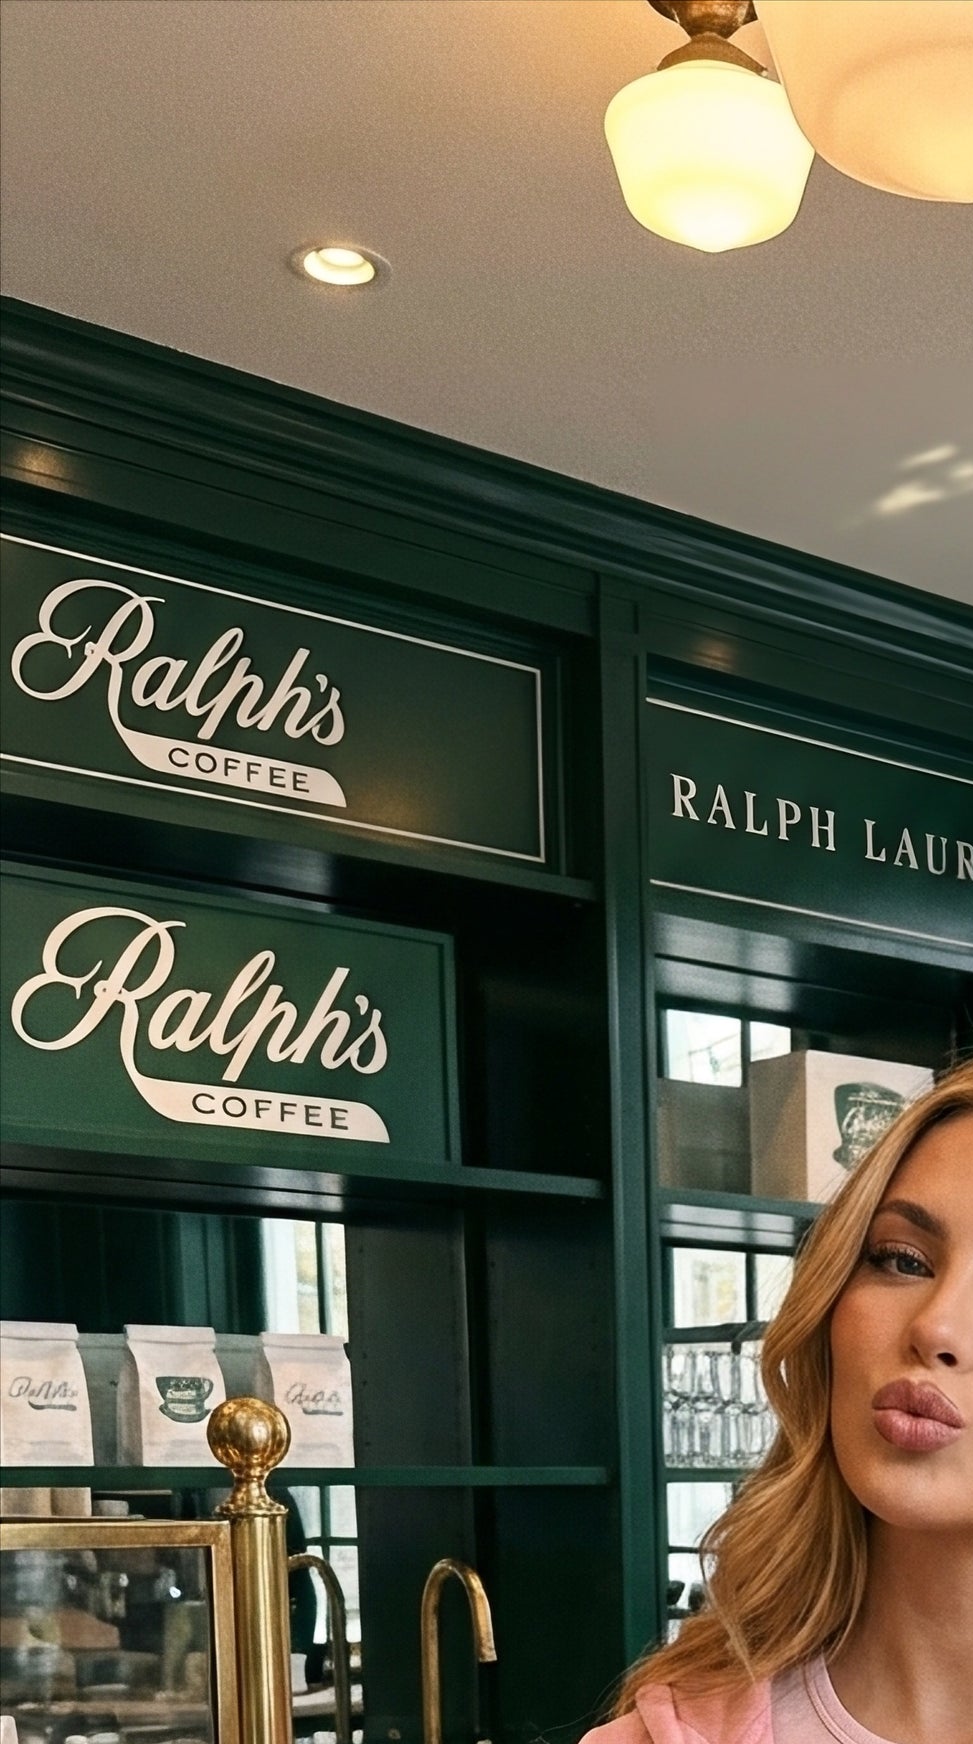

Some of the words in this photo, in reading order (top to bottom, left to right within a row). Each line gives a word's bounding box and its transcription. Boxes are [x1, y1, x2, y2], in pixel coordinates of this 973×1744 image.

[11, 579, 346, 746] Ralph's
[167, 747, 311, 794] COFFEE
[670, 773, 837, 852] RALPH
[11, 906, 389, 1082] Ralph's
[191, 1092, 350, 1131] COFFEE
